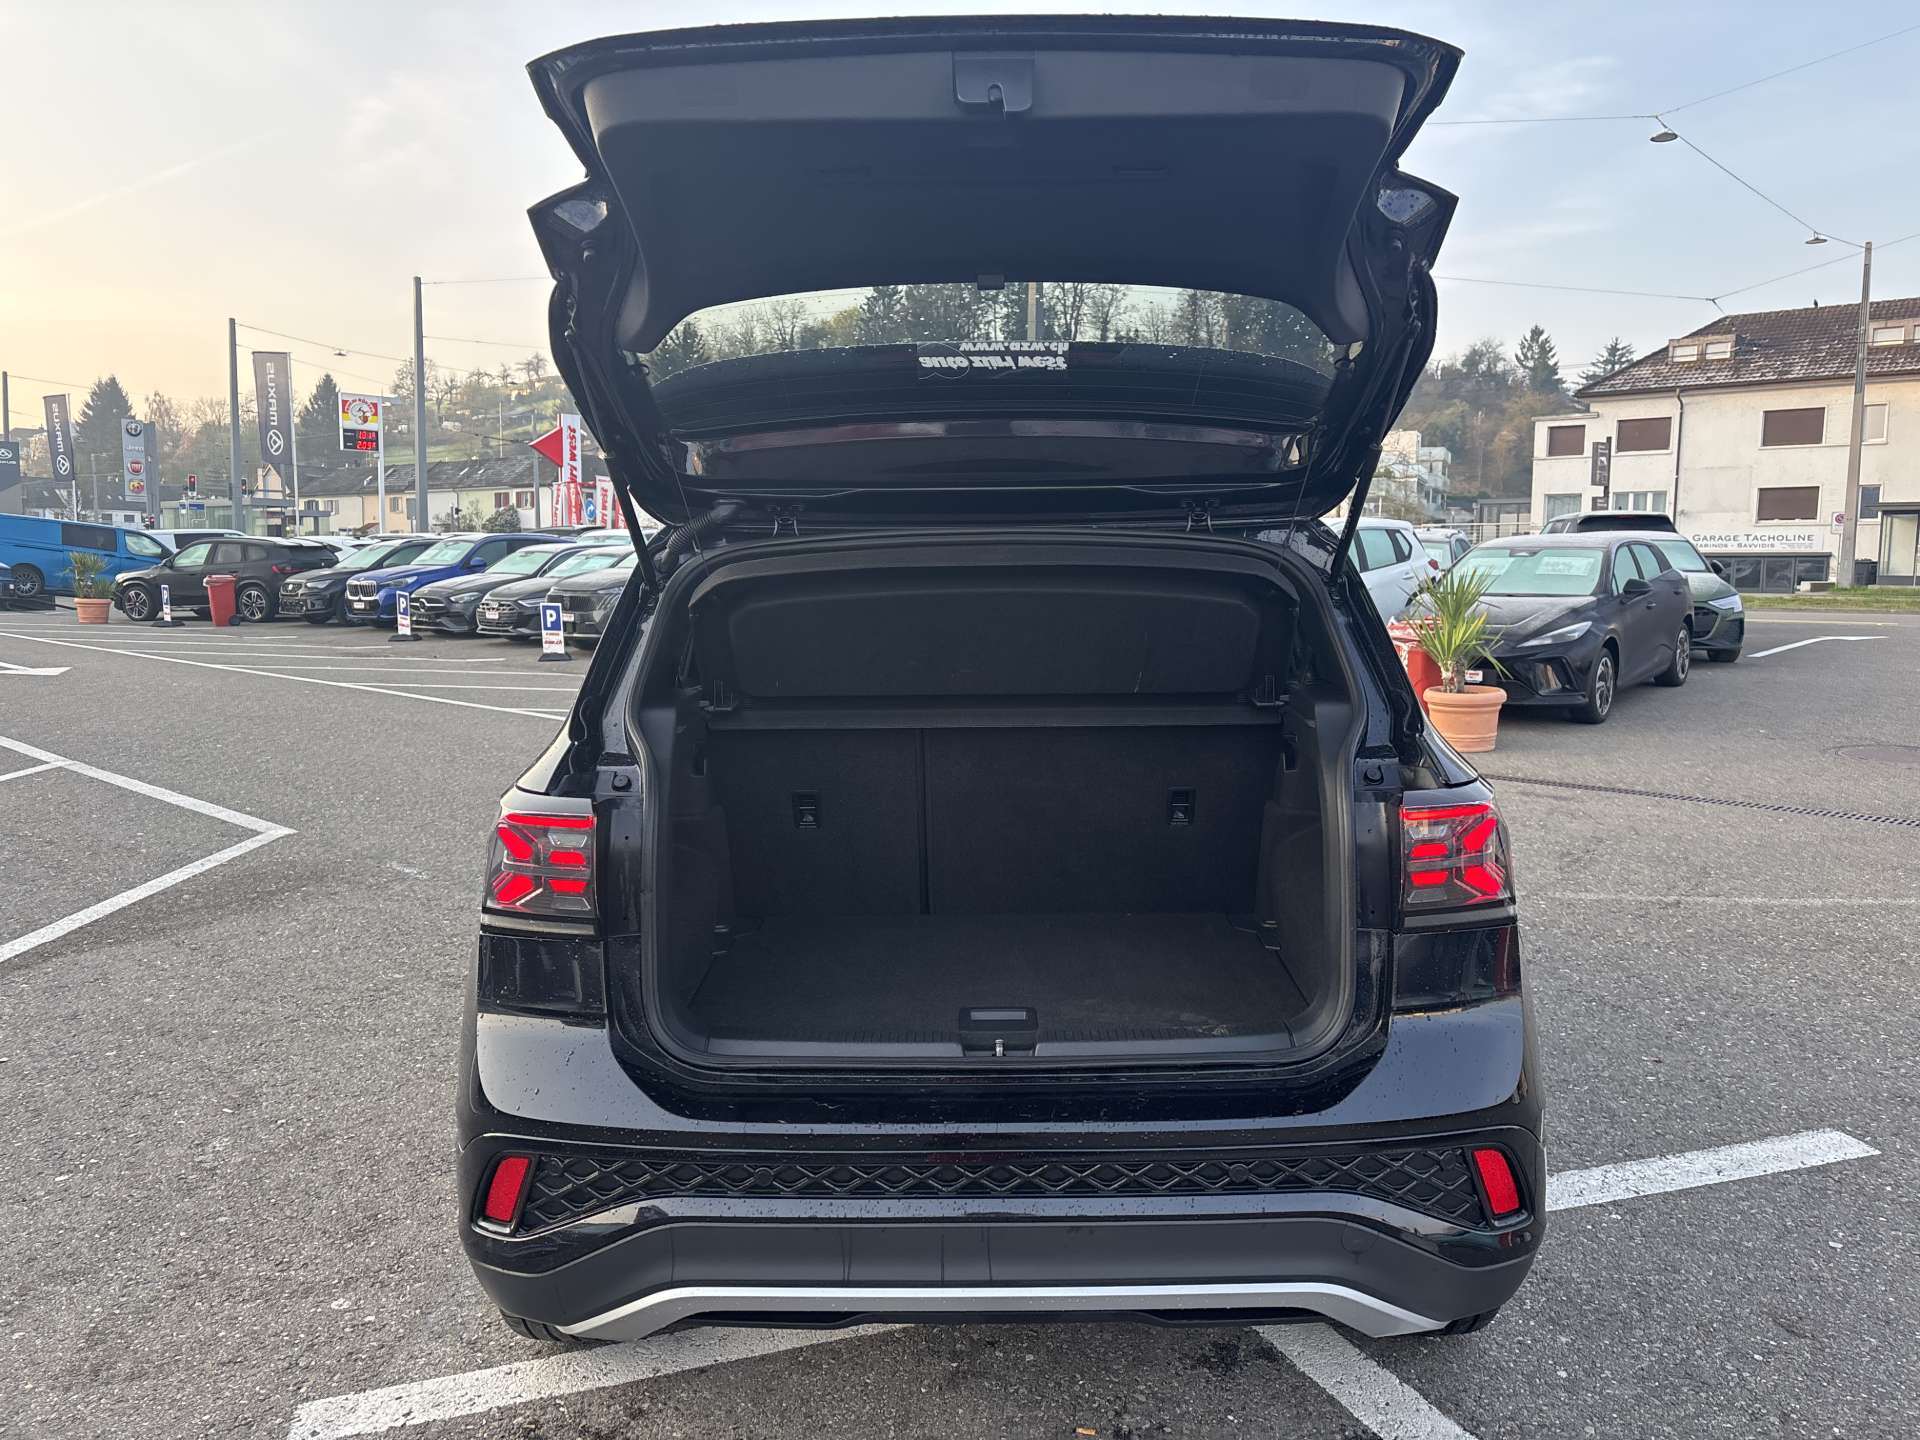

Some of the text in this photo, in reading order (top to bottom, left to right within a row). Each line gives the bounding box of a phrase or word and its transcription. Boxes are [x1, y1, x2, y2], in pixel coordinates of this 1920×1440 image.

[567, 425, 577, 462] west
[1692, 533, 1815, 542] GARAGE TACHOLINE
[399, 597, 407, 613] P
[546, 609, 557, 628] P
